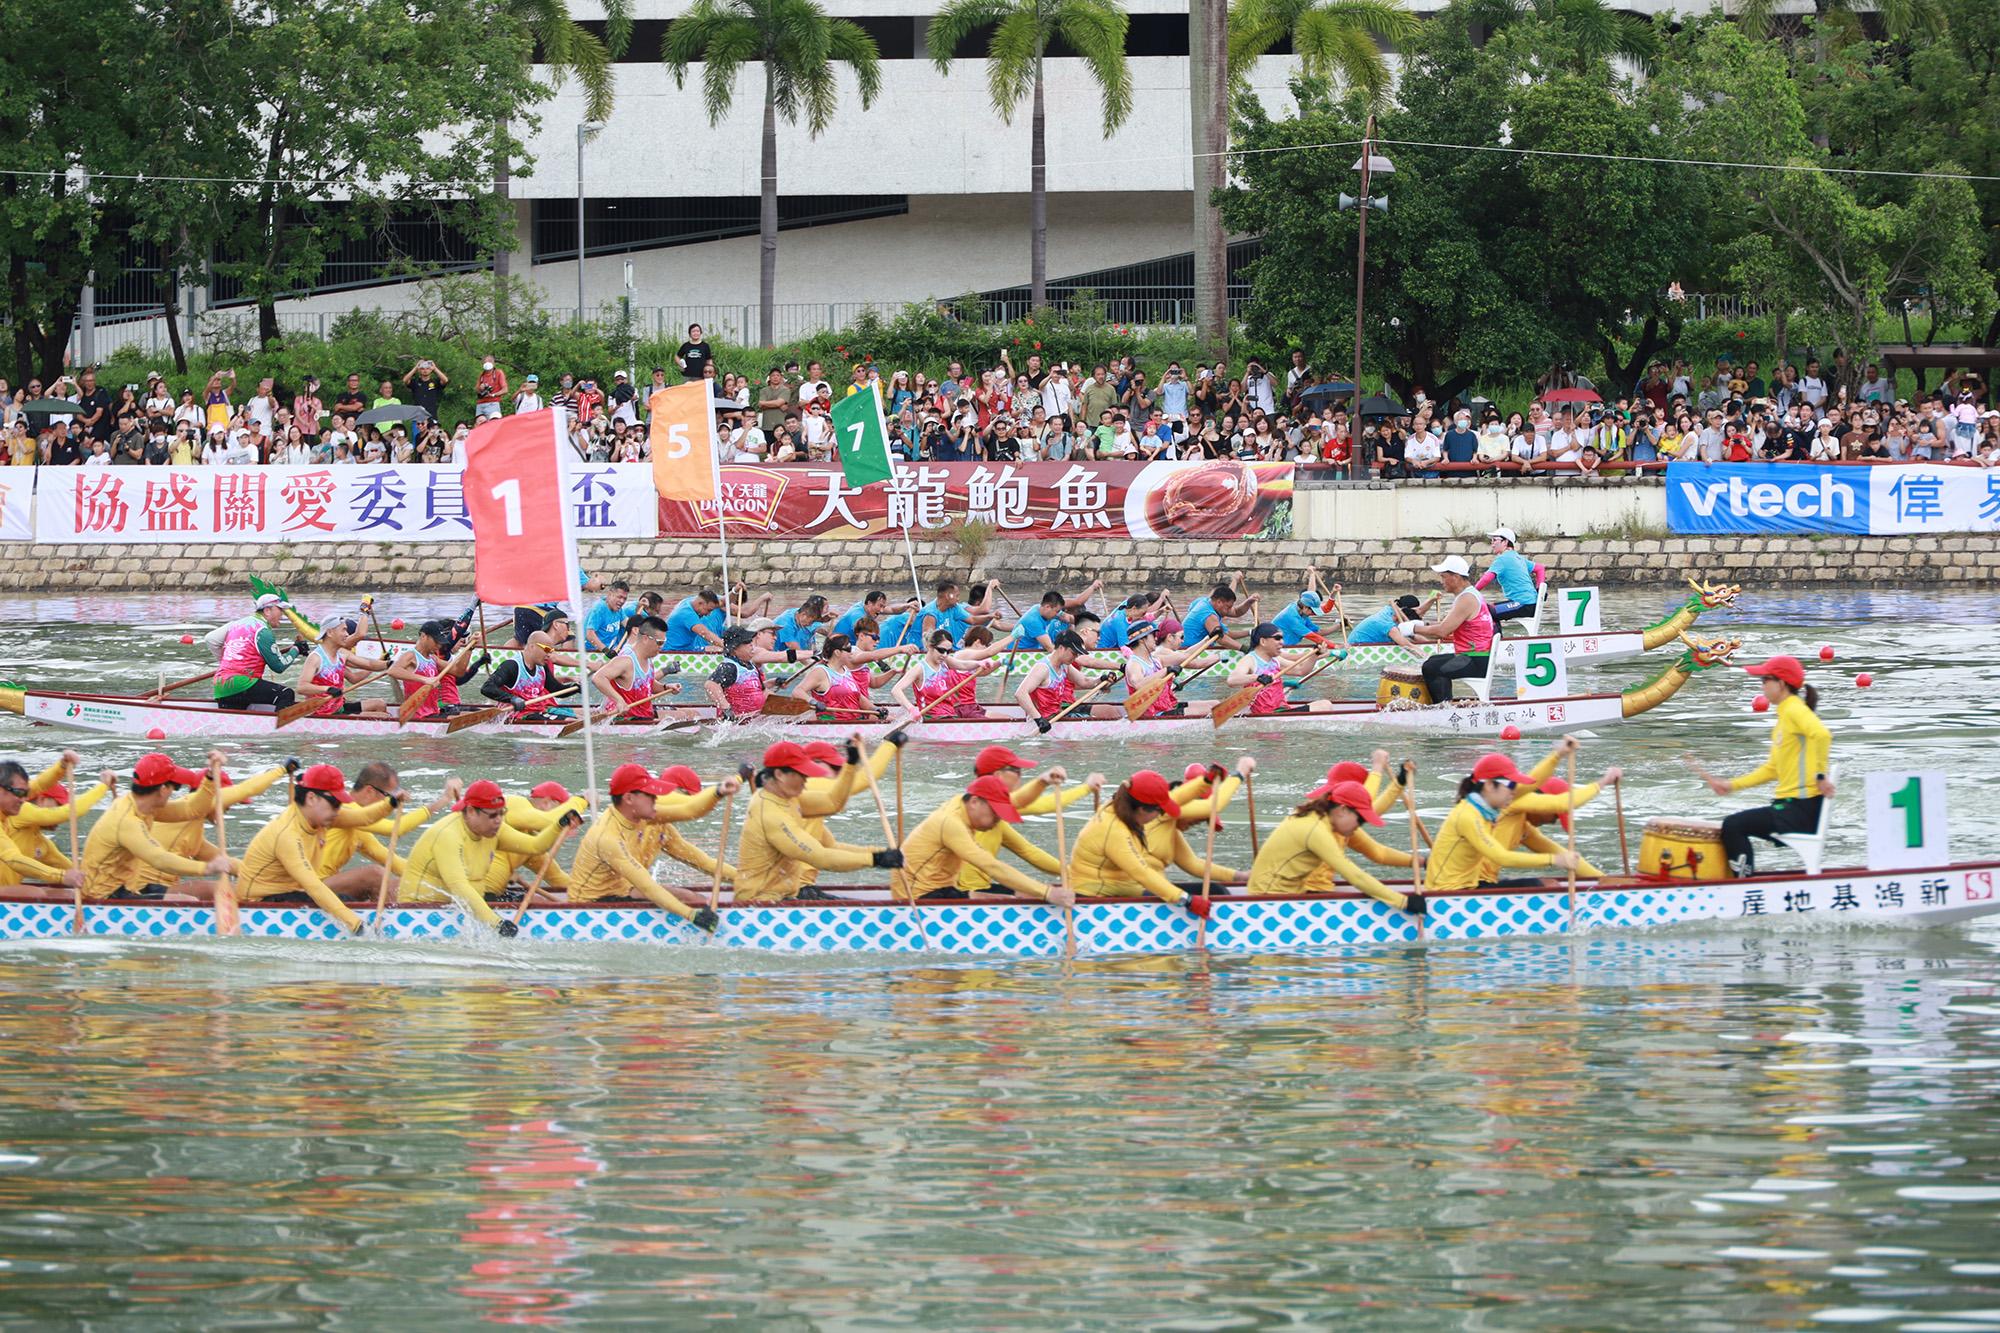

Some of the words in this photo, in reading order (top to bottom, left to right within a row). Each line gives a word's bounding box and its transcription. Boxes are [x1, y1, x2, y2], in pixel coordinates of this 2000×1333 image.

[668, 424, 691, 459] 5
[847, 422, 865, 452] 7
[70, 467, 618, 534] 協盛關愛委員盃
[491, 479, 524, 537] 1
[700, 498, 768, 512] DRAGON
[739, 483, 768, 499] 天龍
[804, 463, 1113, 530] 天龍鮑魚
[1680, 473, 1855, 517] vtech
[1567, 591, 1591, 627] 7
[1525, 643, 1557, 687] 5
[1890, 776, 1924, 848] 1
